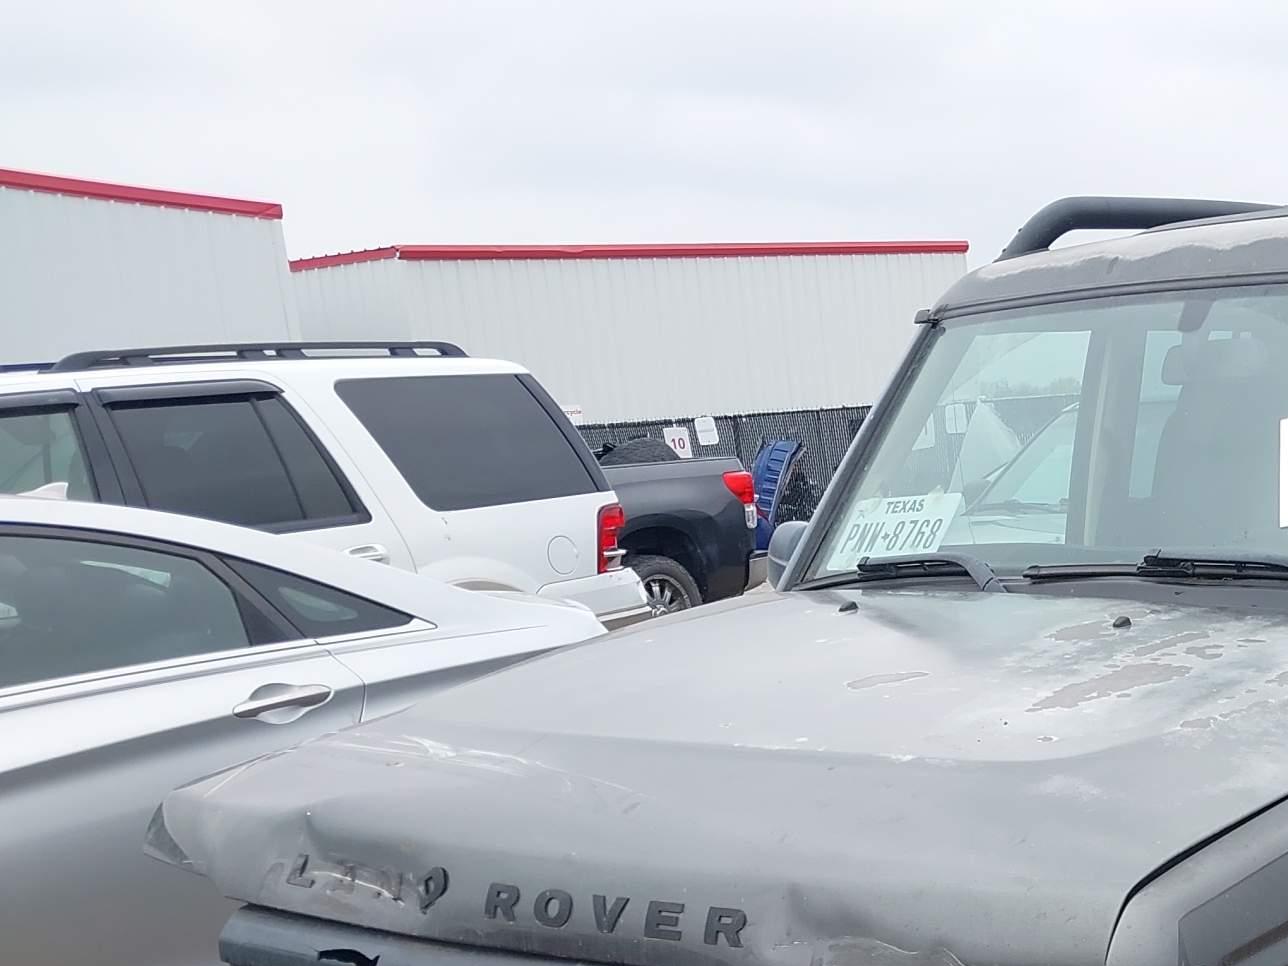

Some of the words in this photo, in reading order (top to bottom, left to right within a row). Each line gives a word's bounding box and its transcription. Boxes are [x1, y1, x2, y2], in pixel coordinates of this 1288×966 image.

[671, 437, 686, 450] 10
[885, 498, 925, 515] TEXAS
[484, 881, 748, 949] ROVER
